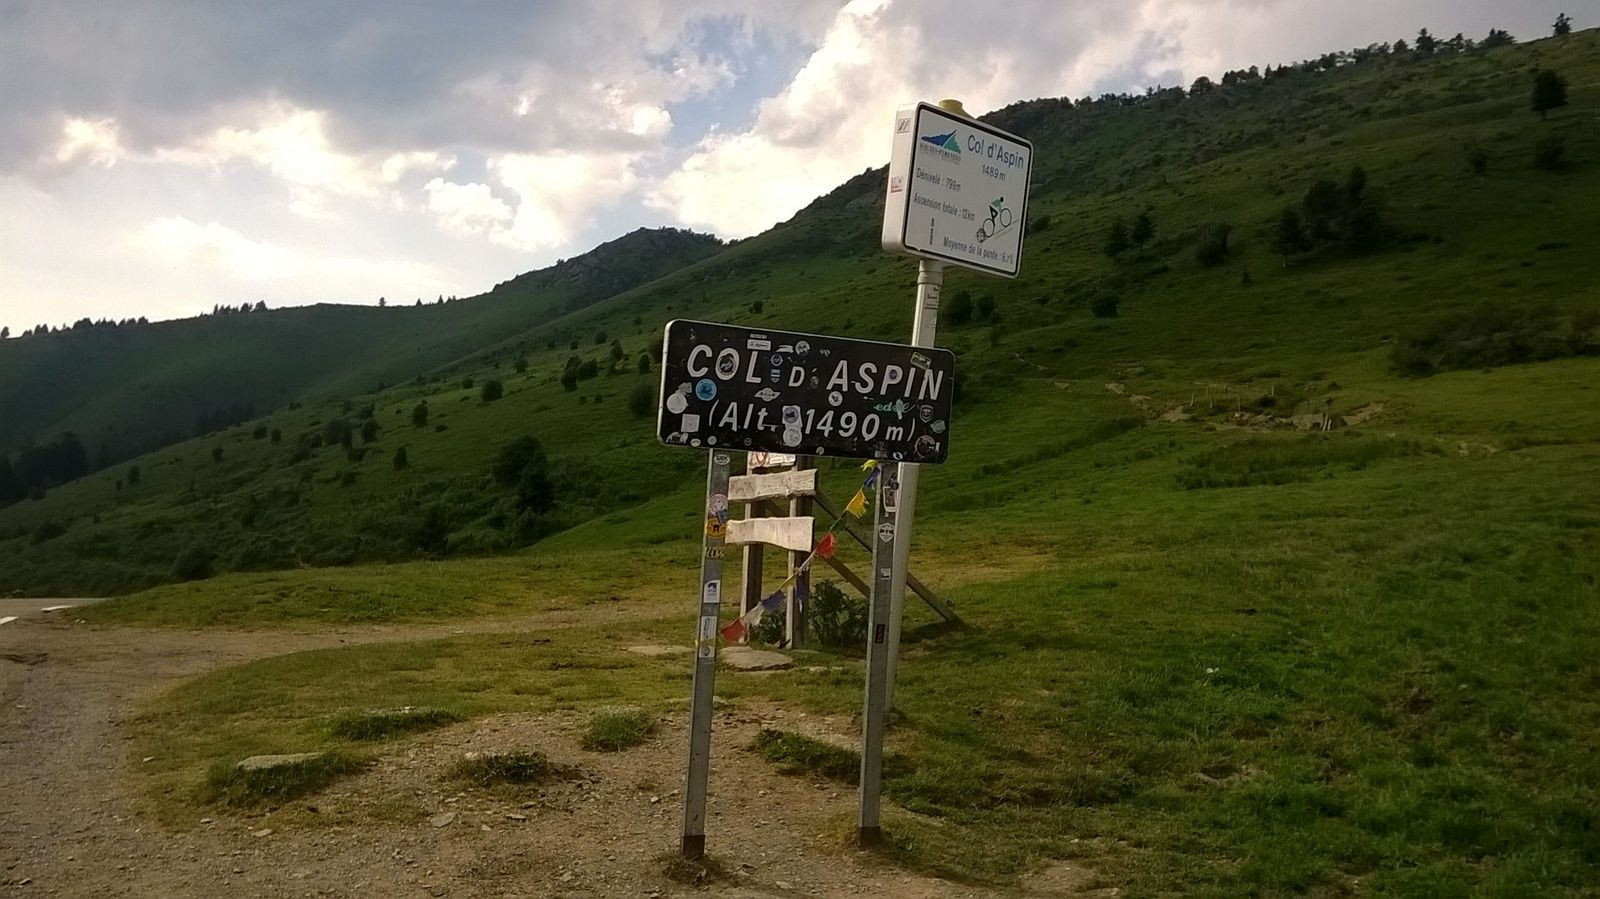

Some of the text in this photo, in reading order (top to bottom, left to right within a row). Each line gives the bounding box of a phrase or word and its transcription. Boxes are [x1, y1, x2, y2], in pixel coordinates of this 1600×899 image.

[967, 134, 1024, 169] Col d'Aspin
[913, 192, 941, 210] Ascension
[942, 202, 958, 216] totale
[943, 236, 968, 252] Moyenne
[968, 244, 976, 255] de
[976, 244, 983, 257] la
[983, 248, 999, 261] pente
[687, 344, 762, 384] COL
[826, 360, 944, 401] ASPIN
[804, 408, 881, 442] 1490
[885, 417, 916, 442] m)
